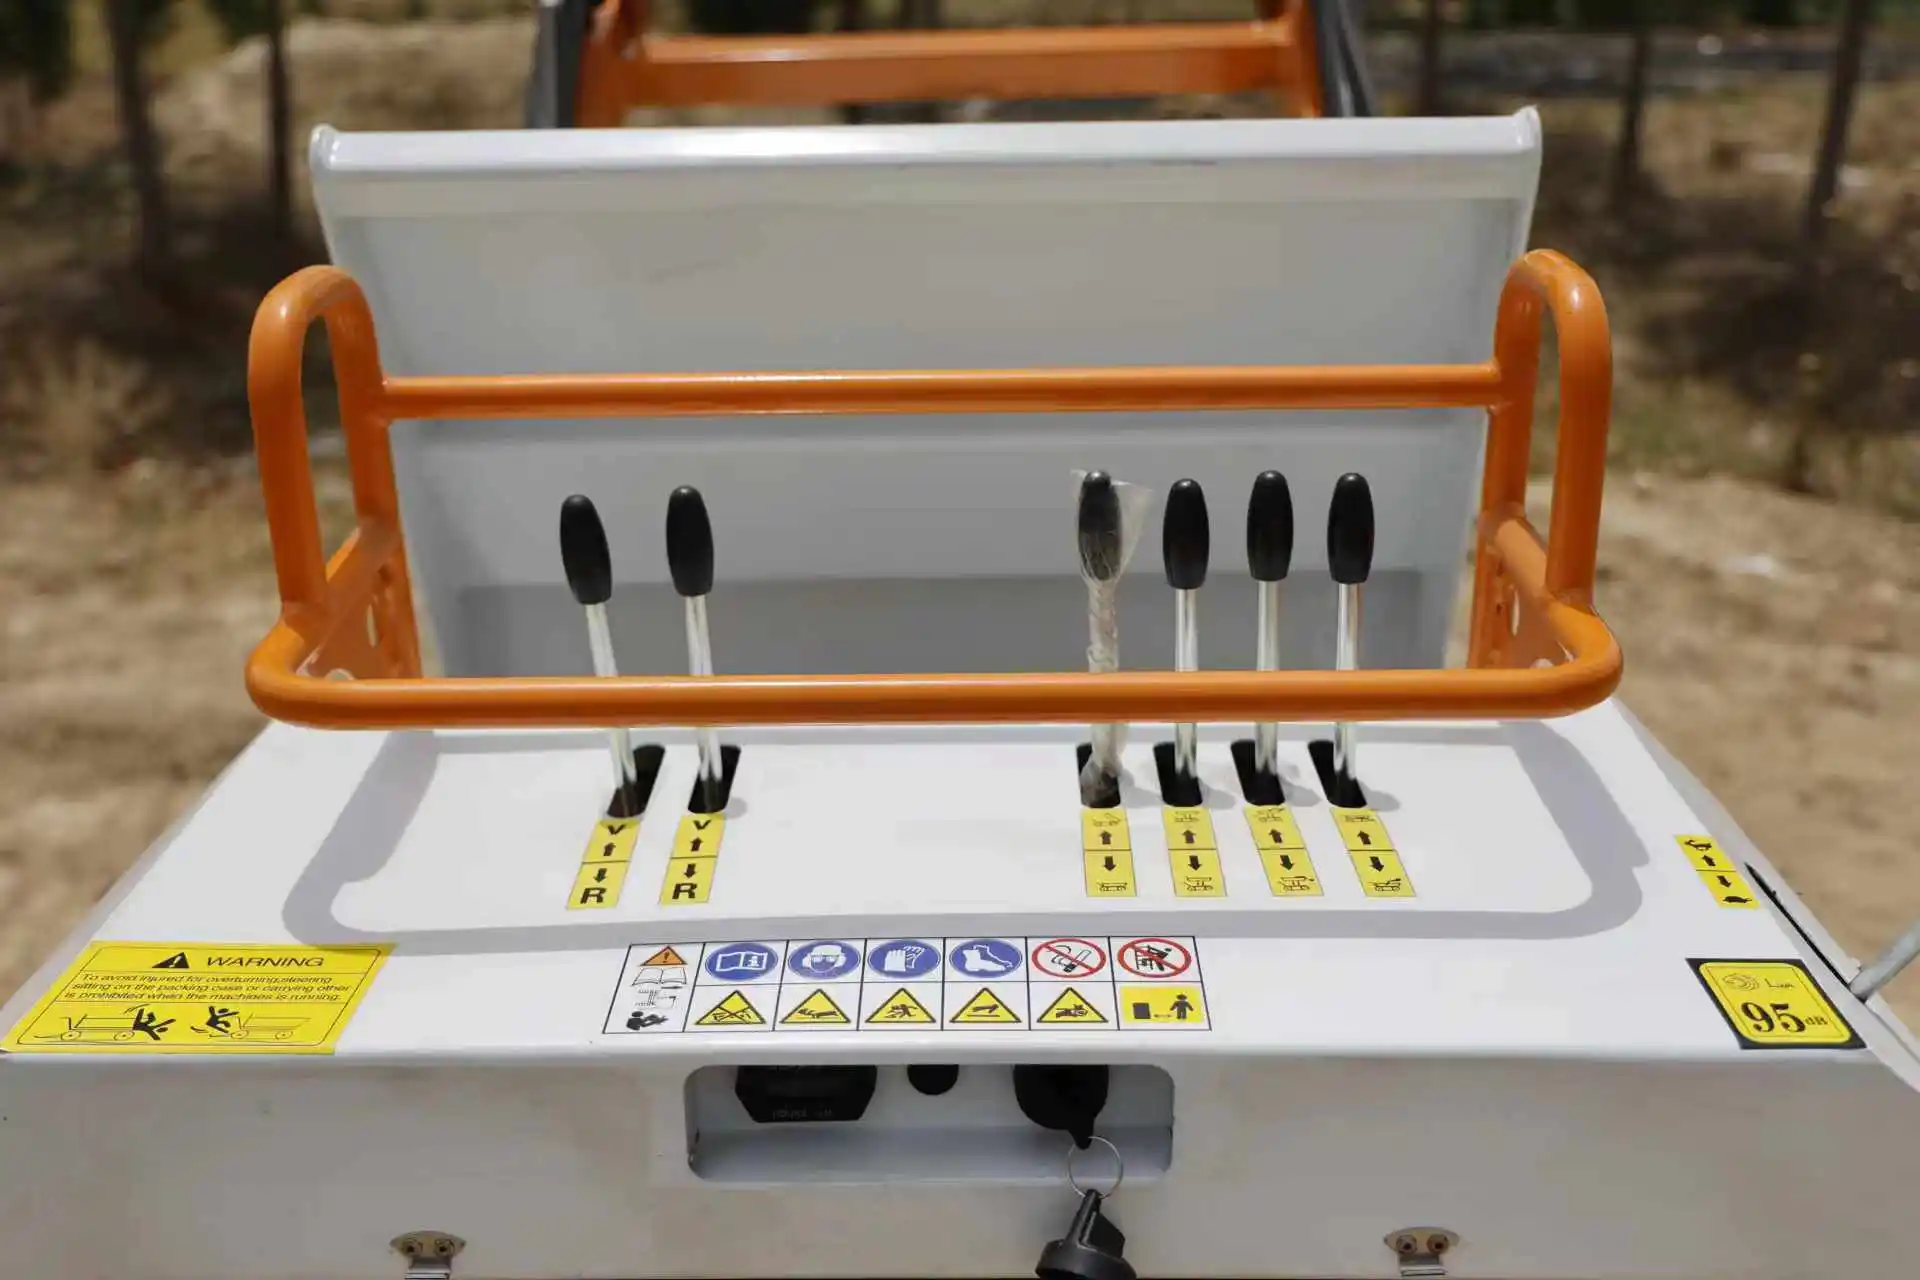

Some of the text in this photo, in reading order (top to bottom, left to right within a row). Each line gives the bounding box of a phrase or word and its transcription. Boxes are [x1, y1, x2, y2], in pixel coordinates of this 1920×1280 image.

[607, 824, 626, 835] V
[693, 819, 712, 830] V
[579, 887, 607, 904] R
[672, 882, 698, 900] R
[207, 957, 325, 967] WARNING
[157, 984, 209, 992] packing
[1741, 1002, 1806, 1033] 95
